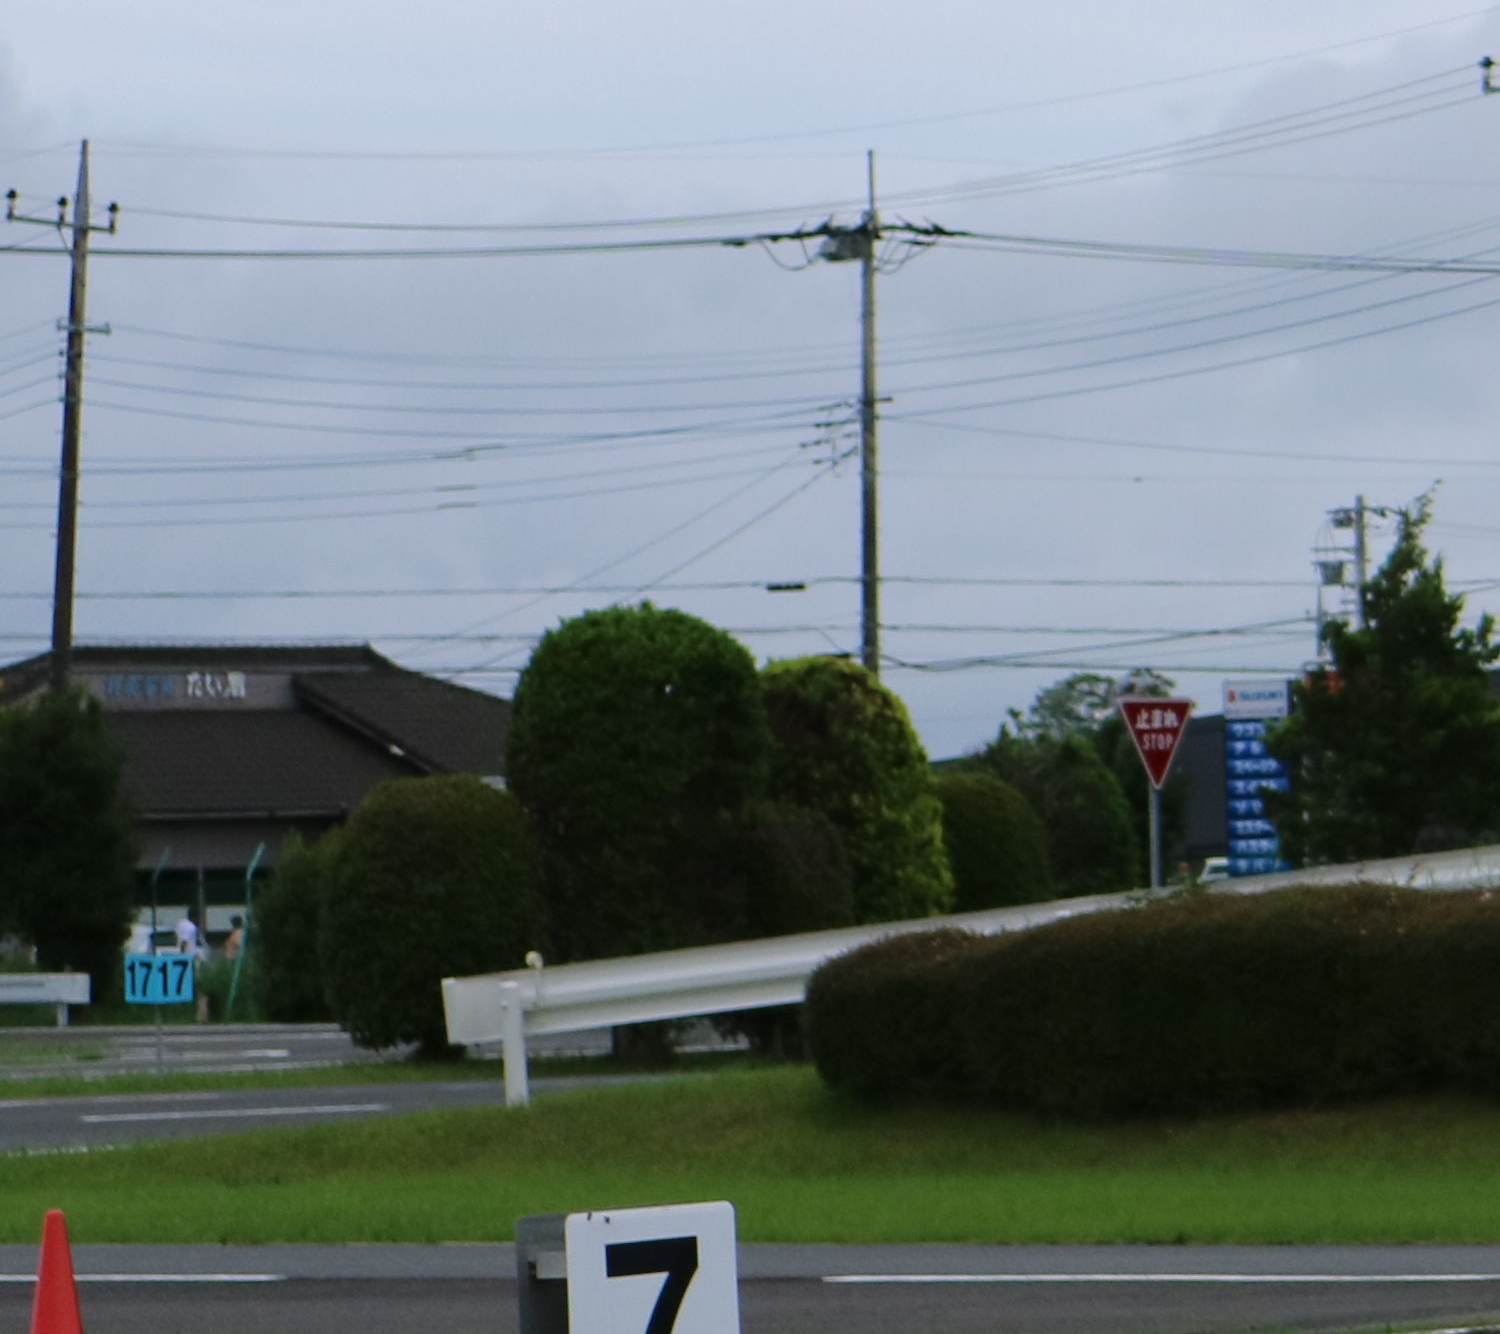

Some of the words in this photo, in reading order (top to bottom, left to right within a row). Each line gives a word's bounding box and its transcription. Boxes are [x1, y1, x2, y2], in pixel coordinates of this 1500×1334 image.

[1134, 708, 1179, 729] 止まれ
[1142, 733, 1174, 750] STOP
